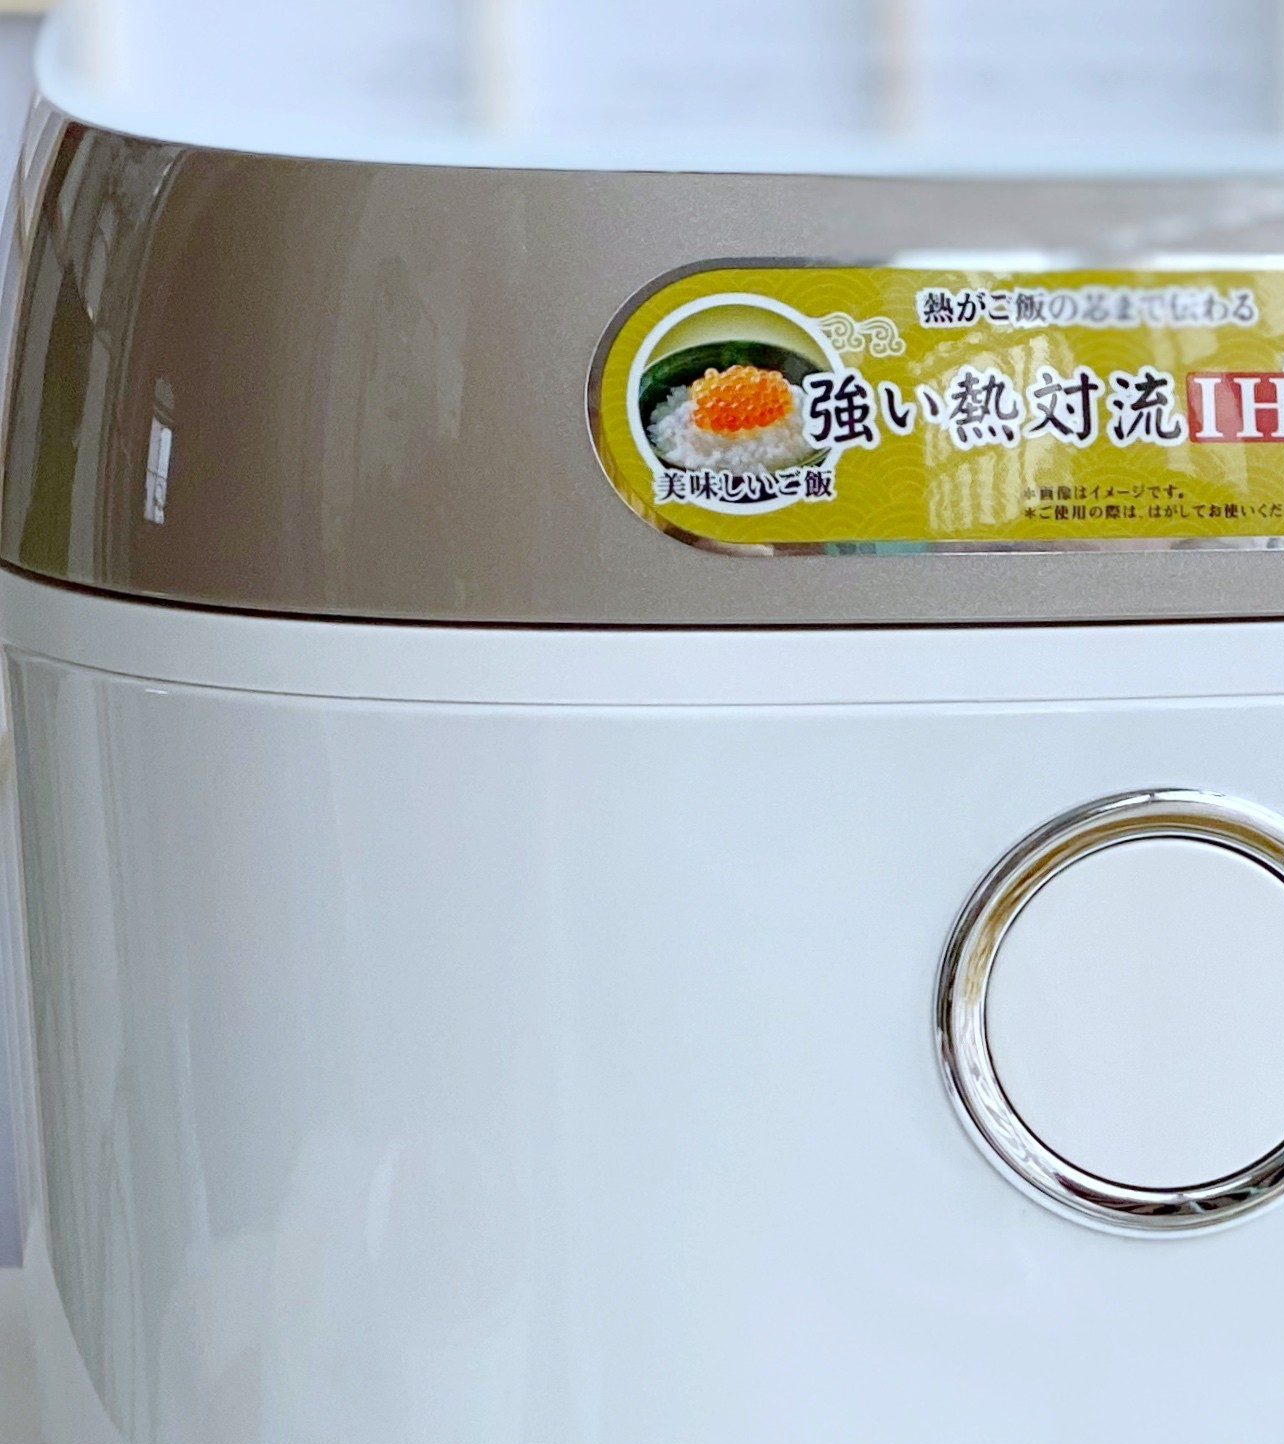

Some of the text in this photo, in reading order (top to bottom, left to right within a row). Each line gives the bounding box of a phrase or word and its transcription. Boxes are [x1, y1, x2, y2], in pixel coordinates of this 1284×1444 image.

[658, 470, 833, 500] 美味しいご飯
